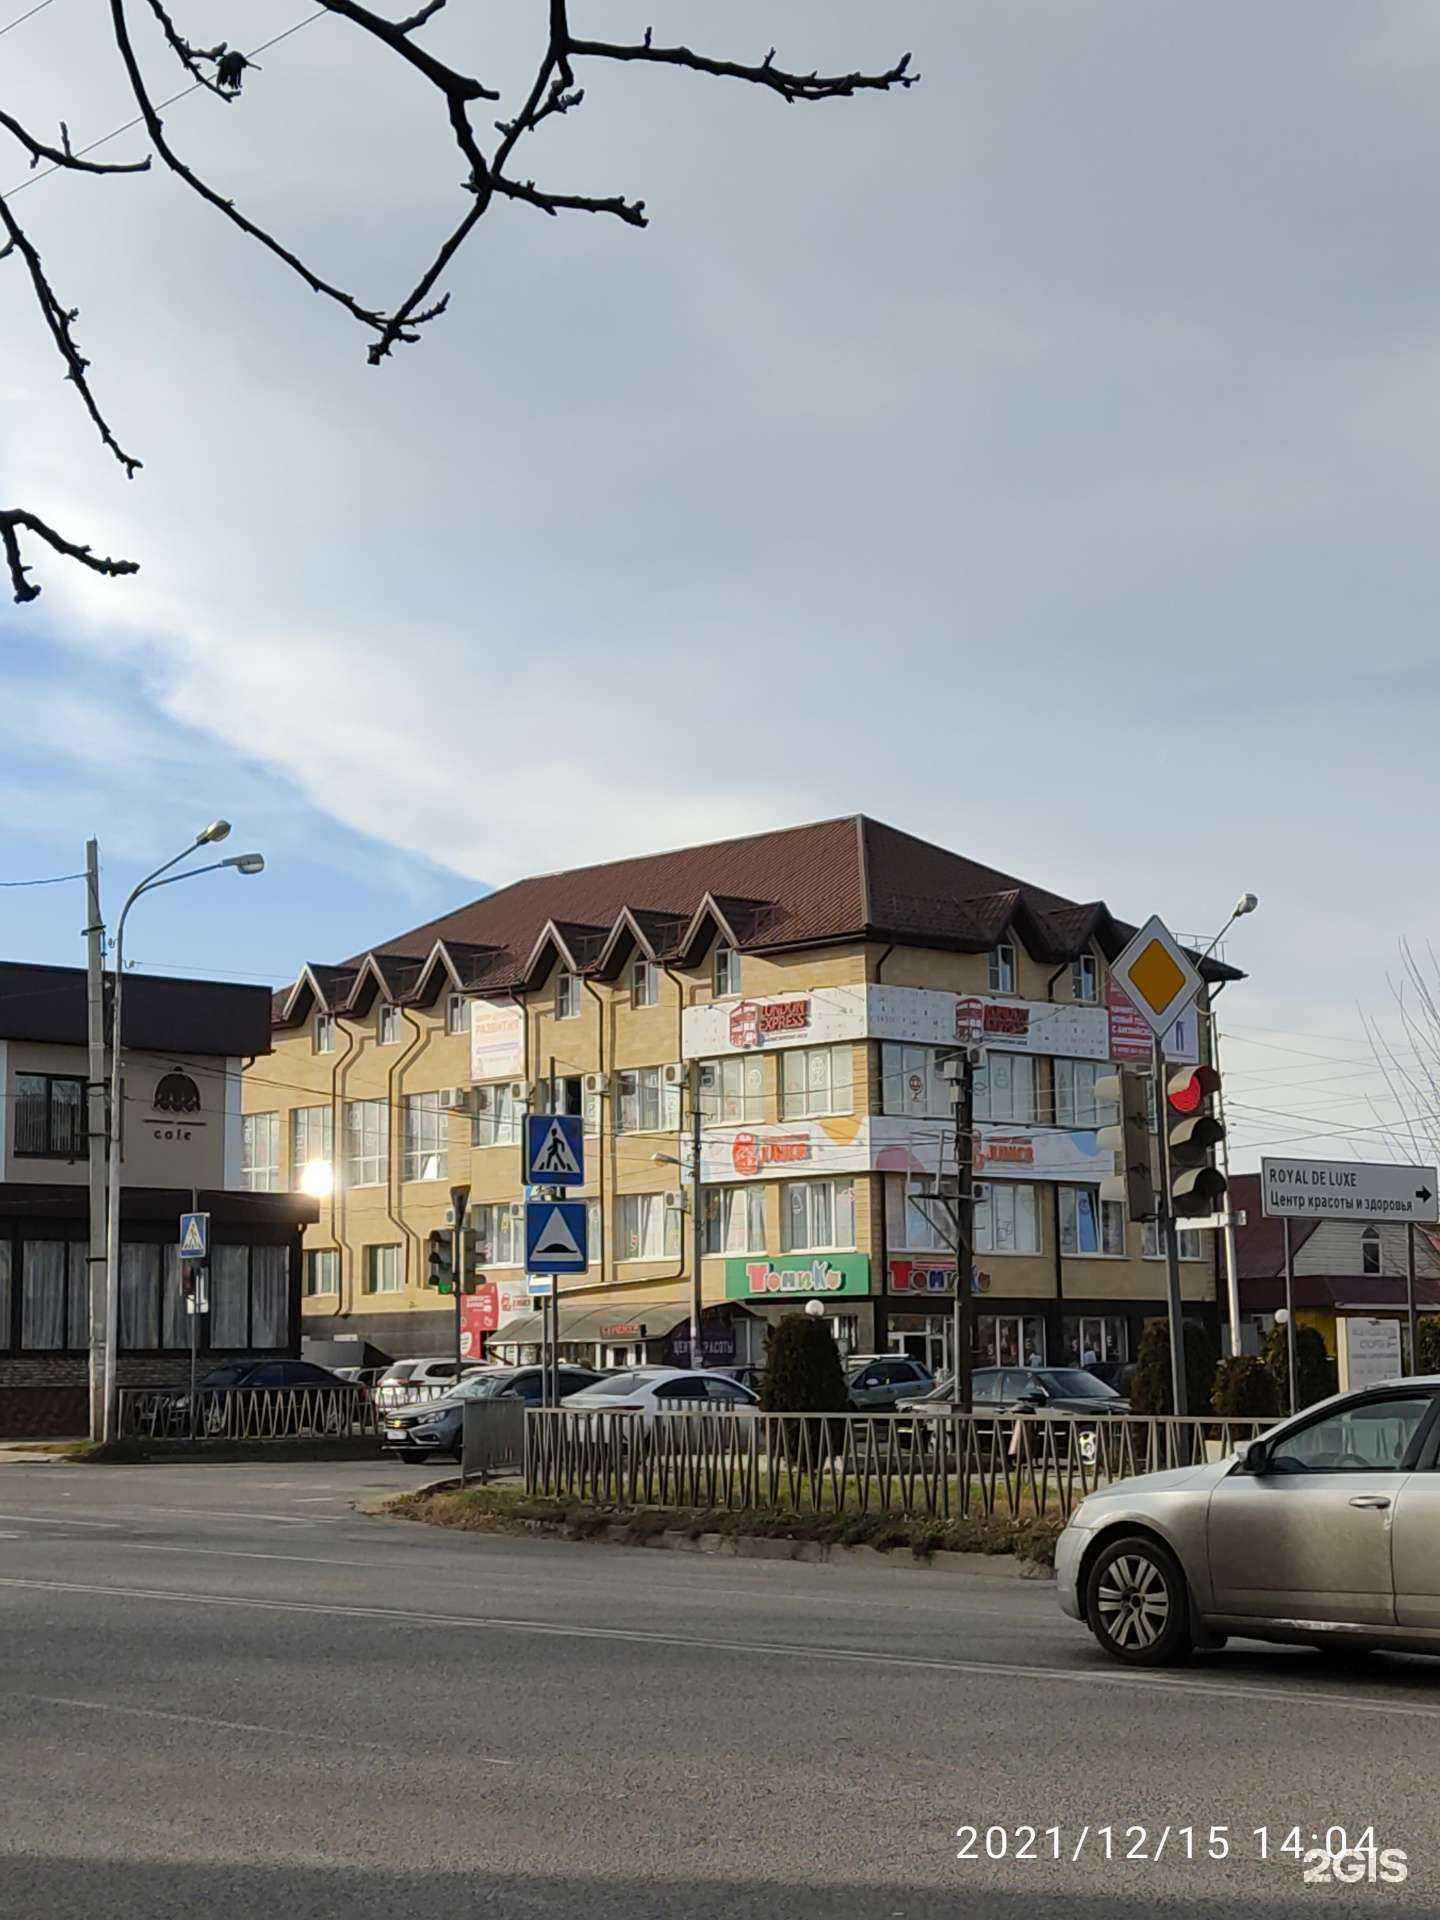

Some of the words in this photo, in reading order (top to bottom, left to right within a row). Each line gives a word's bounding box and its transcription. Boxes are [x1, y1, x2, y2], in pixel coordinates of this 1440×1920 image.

[762, 1000, 806, 1017] LONDON
[760, 1014, 806, 1031] EXPRESS
[153, 1128, 193, 1141] cafe
[1269, 1168, 1309, 1185] ROYAL
[1312, 1170, 1327, 1186] DE
[1329, 1172, 1357, 1187] LUXE
[1271, 1189, 1306, 1210] Центр
[1308, 1195, 1354, 1211] красоты
[1356, 1198, 1363, 1209] и
[1364, 1198, 1413, 1213] здоровья
